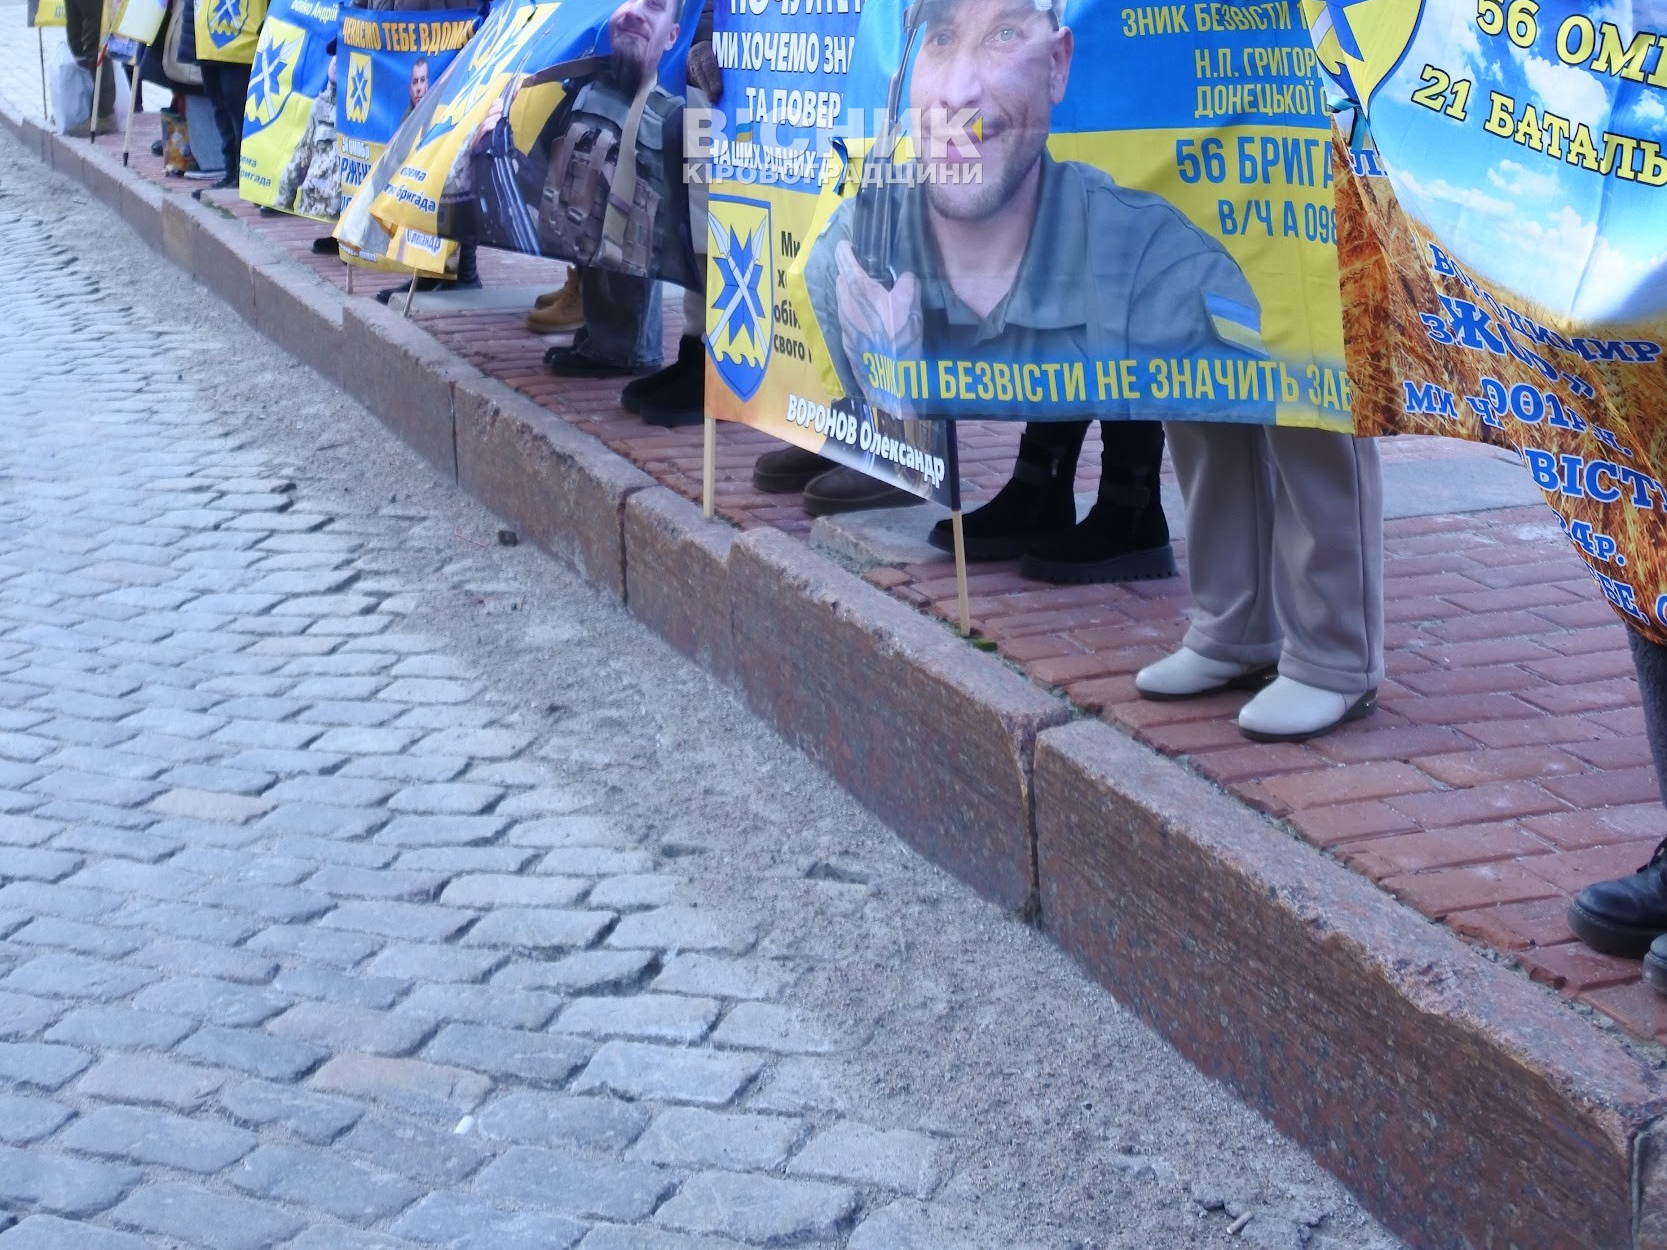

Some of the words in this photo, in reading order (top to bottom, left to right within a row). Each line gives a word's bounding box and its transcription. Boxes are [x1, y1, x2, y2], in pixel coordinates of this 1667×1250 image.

[381, 22, 417, 53] ТЕБЕ
[1121, 4, 1190, 37] ЗНИК
[1194, 0, 1292, 32] БЕЗВІСТИ
[712, 31, 739, 69] МИ
[741, 31, 820, 74] ХОЧЕМО
[1194, 48, 1239, 78] Н.П.
[746, 87, 768, 123] ТА
[772, 88, 843, 129] ПОВЕР
[1194, 81, 1315, 118] ДОНЕЦЬКОЇ
[1411, 63, 1472, 122] 21
[1483, 90, 1667, 187] БАТАЛЬ
[709, 138, 762, 170] НАШИХ
[1175, 137, 1227, 184] 56
[1237, 136, 1334, 189] БРИГА
[1218, 200, 1274, 237] В/Ч
[1283, 200, 1299, 238] А
[773, 333, 805, 361] свого
[863, 351, 929, 400] ЗНИКЛІ
[938, 359, 1087, 403] БЕЗВІСТИ
[1095, 359, 1141, 401] НЕ
[1148, 358, 1300, 403] ЗНАЧИТЬ
[1403, 380, 1459, 419] МИ
[786, 393, 858, 446] ВОРОНОВ
[859, 417, 946, 490] Олександр
[1513, 442, 1667, 512] ВІСТ
